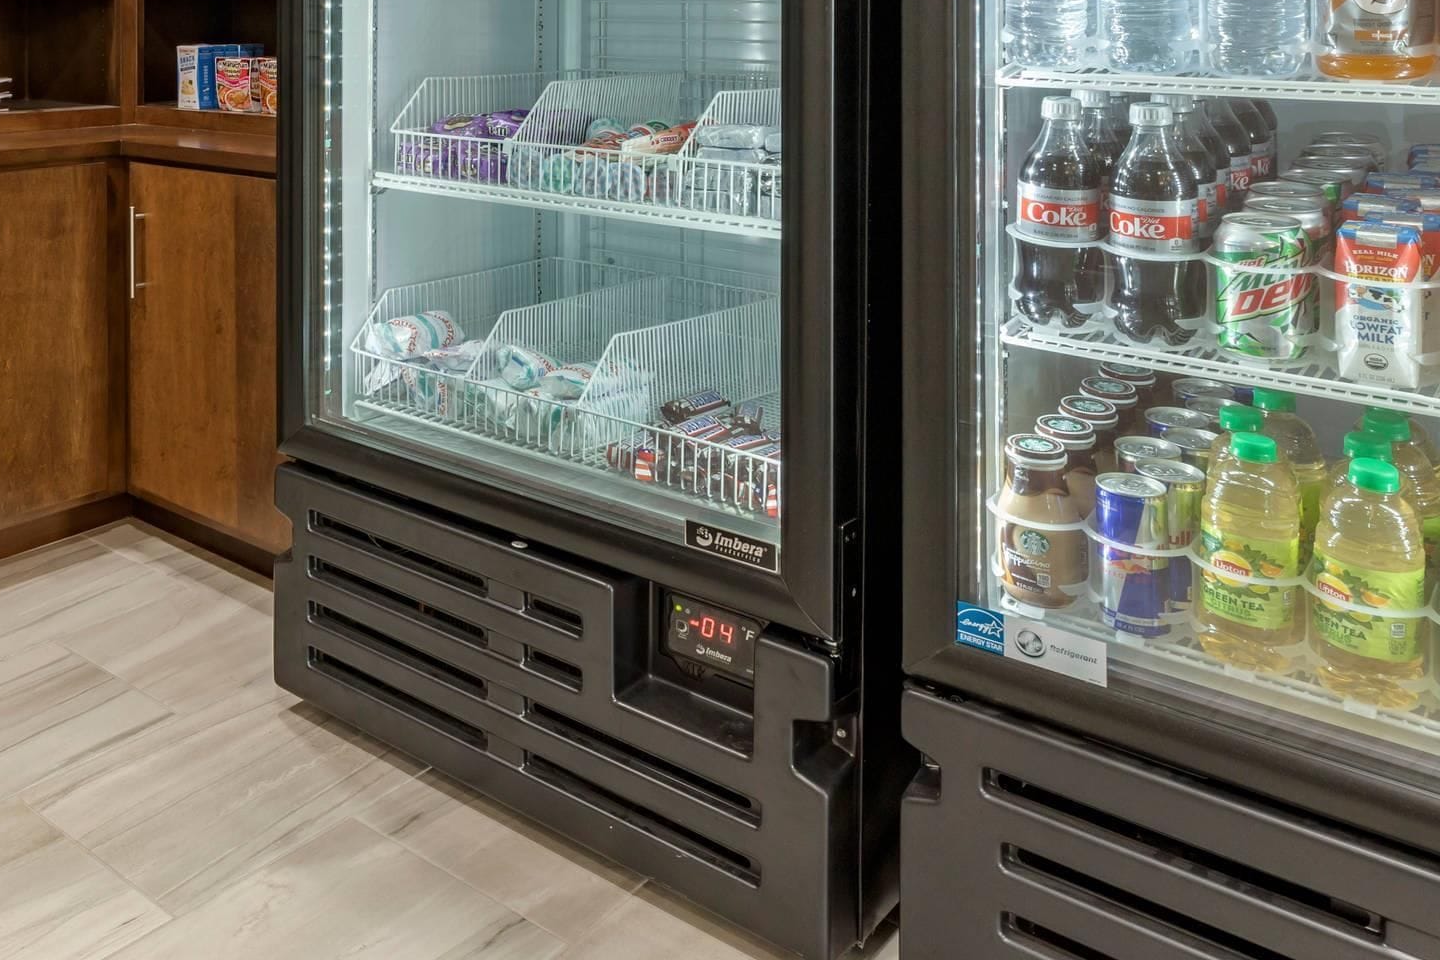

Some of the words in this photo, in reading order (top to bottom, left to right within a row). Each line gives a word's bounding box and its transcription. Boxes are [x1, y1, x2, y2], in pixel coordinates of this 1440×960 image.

[1027, 202, 1088, 226] Coke
[1110, 211, 1166, 239] Coke
[1376, 250, 1399, 259] MILK
[1345, 256, 1409, 279] HORIZON
[1352, 314, 1400, 326] ORGANIC
[1357, 332, 1395, 345] MILK
[714, 532, 764, 557] Imbera
[1215, 559, 1247, 577] Lipton
[1203, 584, 1238, 606] GREEN
[1240, 600, 1265, 612] TEA
[1319, 581, 1346, 601] Lipton
[959, 632, 985, 646] ENERGY
[985, 641, 1003, 652] STAR
[1341, 625, 1367, 641] TEA
